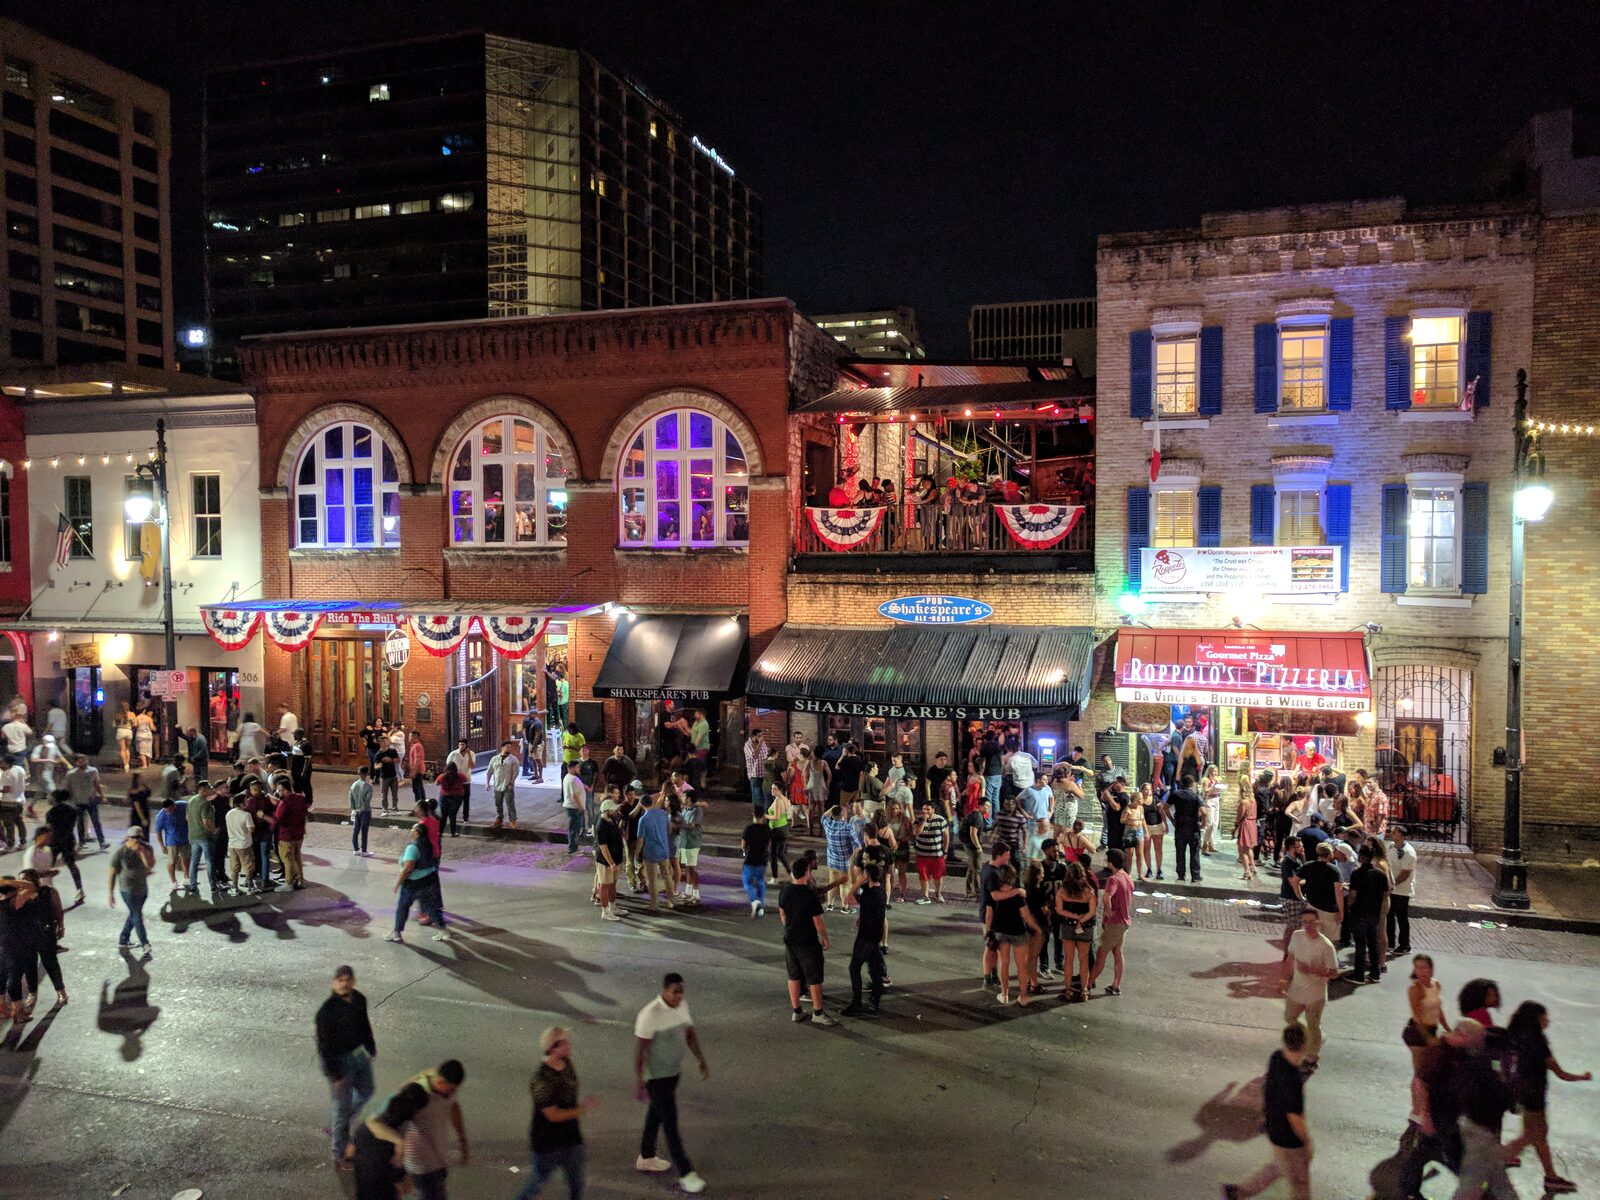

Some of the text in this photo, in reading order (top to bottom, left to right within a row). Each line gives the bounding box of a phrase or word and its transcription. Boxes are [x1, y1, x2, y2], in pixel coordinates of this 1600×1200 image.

[926, 597, 943, 605] PUB
[888, 602, 982, 616] Shakespeare's
[327, 612, 394, 623] Ride The Bull
[388, 651, 408, 666] WILD
[1206, 650, 1275, 661] Gourmet Pizza
[242, 673, 258, 682] 306
[1131, 658, 1355, 690] ROPPOLO'S PIZZERIA
[610, 688, 709, 700] SHAKESPEARE'S PUB
[1134, 691, 1149, 701] Da
[1154, 691, 1197, 703] Vincis
[1211, 693, 1260, 706] Birreria
[1265, 696, 1273, 706] &
[1279, 696, 1312, 707] Wine
[1317, 697, 1365, 709] Garden
[795, 699, 1021, 719] SHAKESPEARE'S PUB
